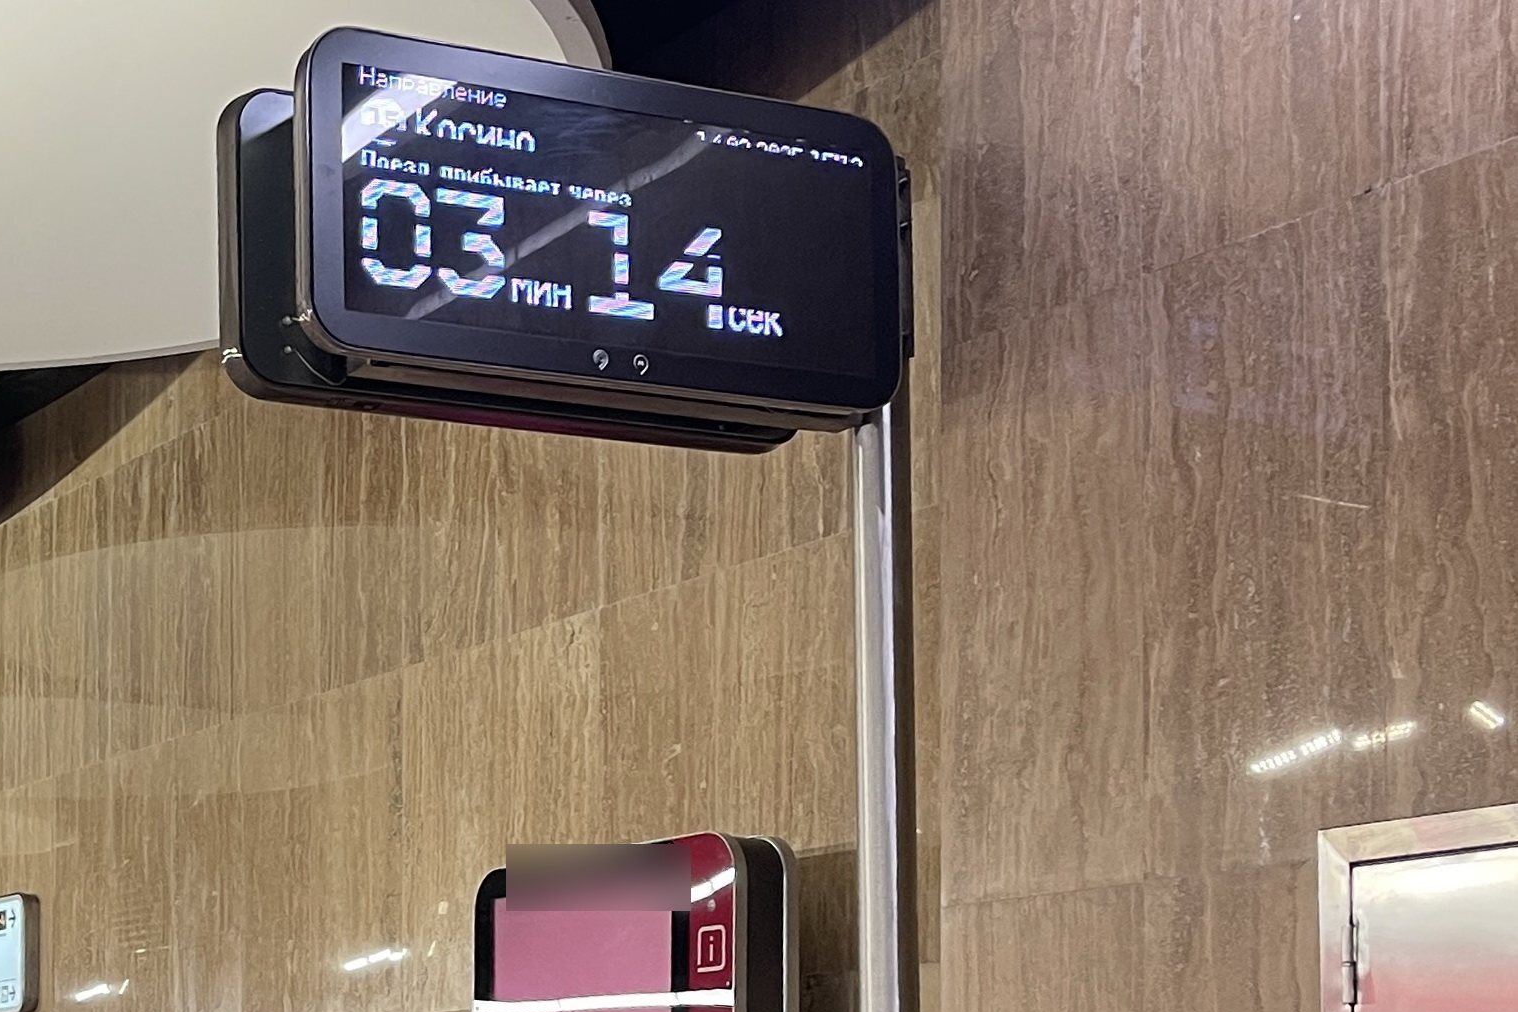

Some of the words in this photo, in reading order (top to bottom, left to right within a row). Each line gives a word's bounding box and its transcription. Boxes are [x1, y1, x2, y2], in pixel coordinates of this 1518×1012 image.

[358, 64, 507, 110] Направление
[360, 147, 431, 176] Поезд
[438, 164, 561, 196] прибывает
[568, 182, 633, 208] через
[360, 177, 507, 300] 03
[510, 275, 573, 311] мин
[587, 209, 725, 331] 14
[726, 304, 783, 337] сек
